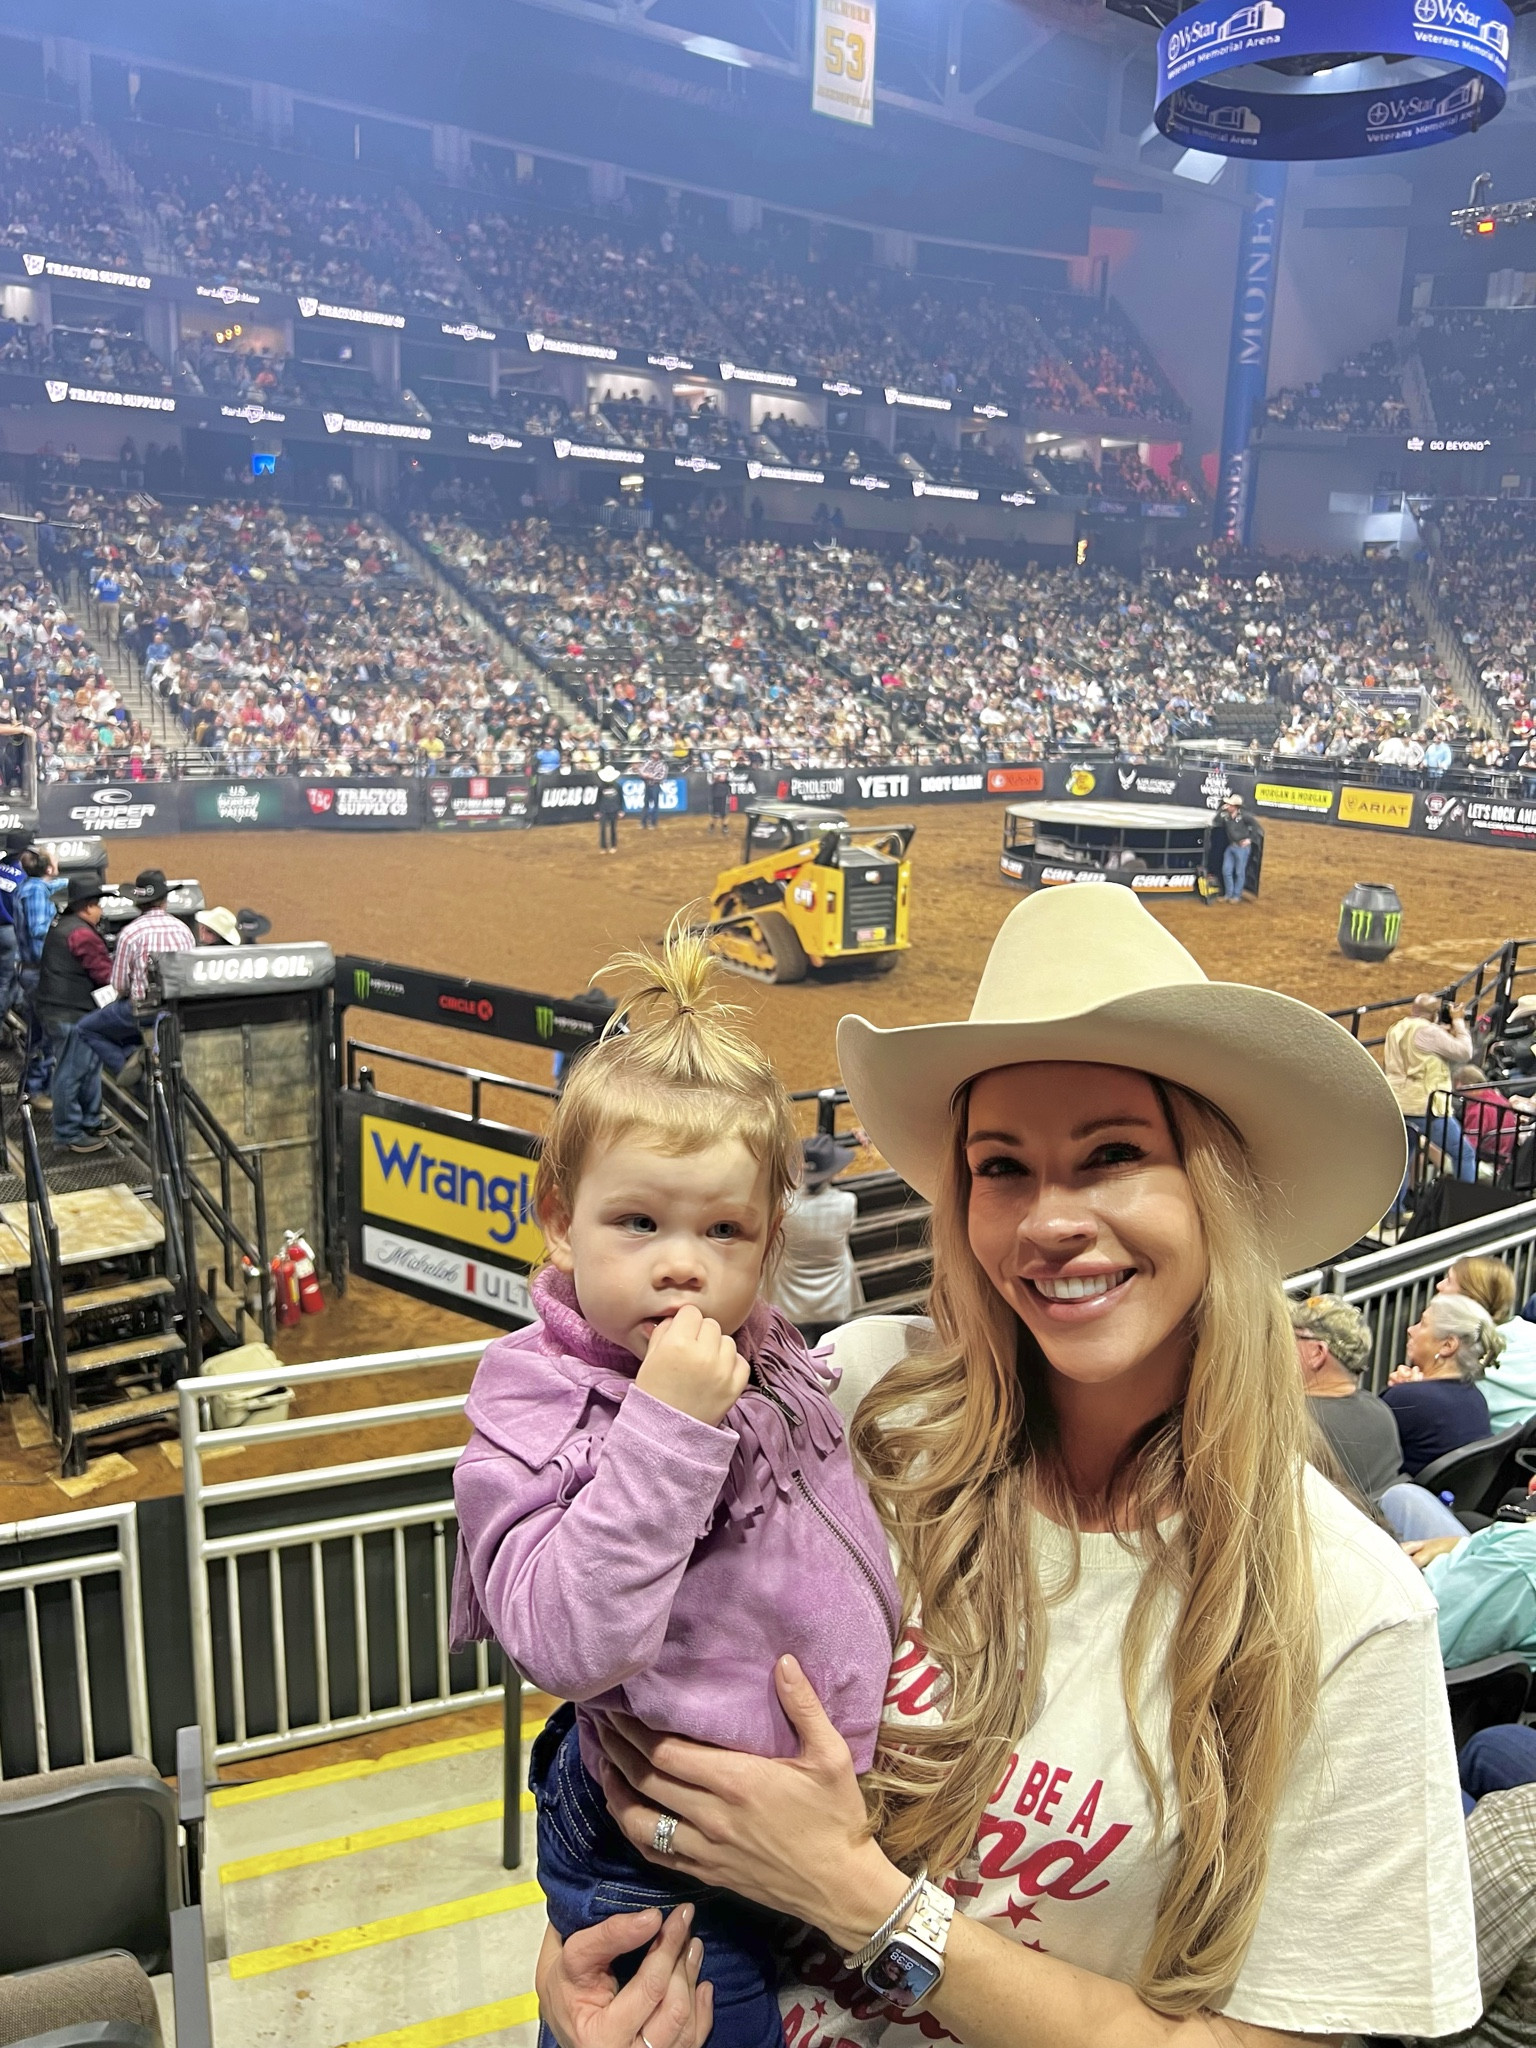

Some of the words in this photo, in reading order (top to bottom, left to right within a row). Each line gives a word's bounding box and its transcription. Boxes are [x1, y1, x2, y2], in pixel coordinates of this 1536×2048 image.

[1437, 0, 1481, 28] VyStar
[1198, 40, 1243, 63] Memorial
[1246, 34, 1281, 49] Arena
[1414, 31, 1460, 48] Veterans
[824, 25, 865, 82] 53
[1389, 97, 1436, 122] VyStar
[1367, 129, 1412, 142] Veterans
[46, 262, 99, 282] TRACTOR
[69, 387, 123, 405] TRACTOR
[1429, 441, 1445, 451] GO
[337, 787, 408, 804] TRACTOR
[541, 785, 583, 808] LUCAS
[791, 777, 845, 796] PENDLETON
[857, 775, 909, 799] YETI
[70, 804, 156, 820] COOPER
[337, 801, 390, 816] SUPPLY
[1358, 804, 1408, 817] ARIAT
[1467, 803, 1491, 820] LET'S
[1491, 805, 1515, 823] ROCK
[83, 818, 142, 831] TIRES
[193, 957, 268, 982] LUCAS
[271, 955, 309, 978] OIL
[438, 994, 477, 1015] CIRCLE
[371, 1130, 530, 1244] Wrangl
[377, 1238, 461, 1284] Michelob
[482, 1270, 530, 1309] ULT
[1013, 1759, 1074, 1827] BE
[1066, 1778, 1104, 1839] A
[890, 1951, 914, 1971] 8:38
